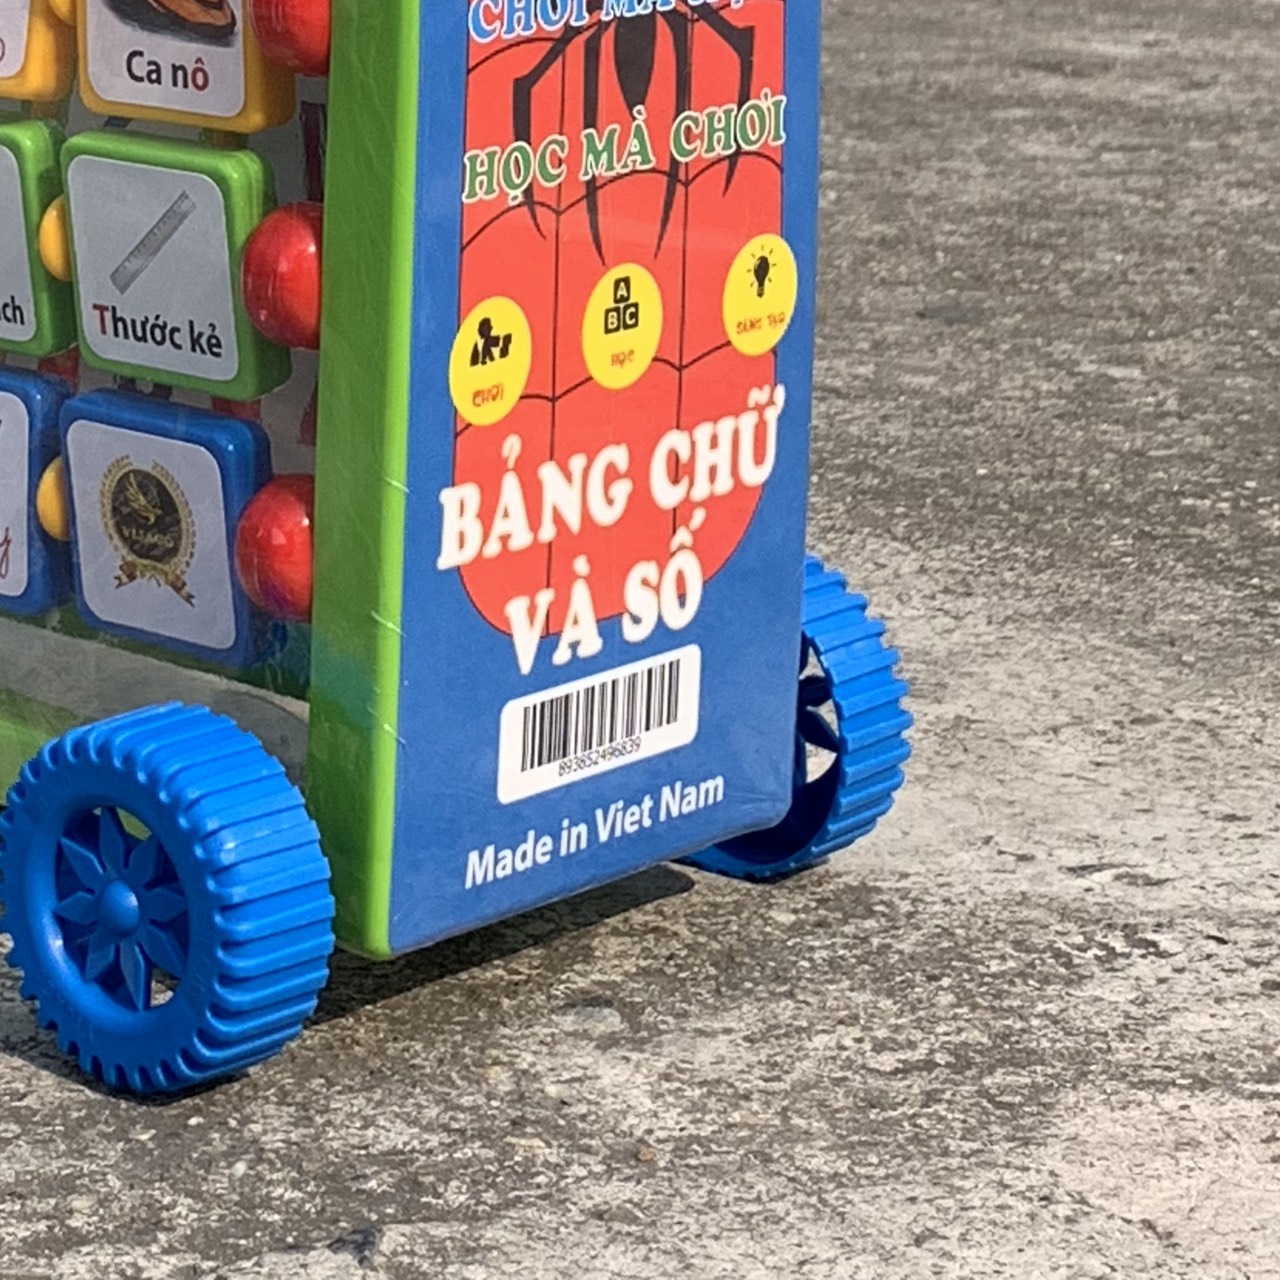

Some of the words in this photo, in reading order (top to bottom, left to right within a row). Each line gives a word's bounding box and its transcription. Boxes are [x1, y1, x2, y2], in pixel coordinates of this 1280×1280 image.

[126, 49, 163, 87] Ca
[171, 57, 209, 93] nô
[462, 133, 569, 204] HỌC
[579, 104, 656, 182] MÀ
[670, 88, 786, 163] CHƠI
[92, 303, 183, 351] Thước
[189, 319, 223, 358] kẻ
[436, 434, 633, 570] BẢNG
[649, 384, 785, 511] CHỮ
[504, 554, 603, 675] VÀ
[621, 507, 706, 643] SỐ
[465, 830, 553, 889] Made
[560, 818, 588, 857] in
[595, 794, 654, 844] Viet
[658, 775, 725, 821] Nam
